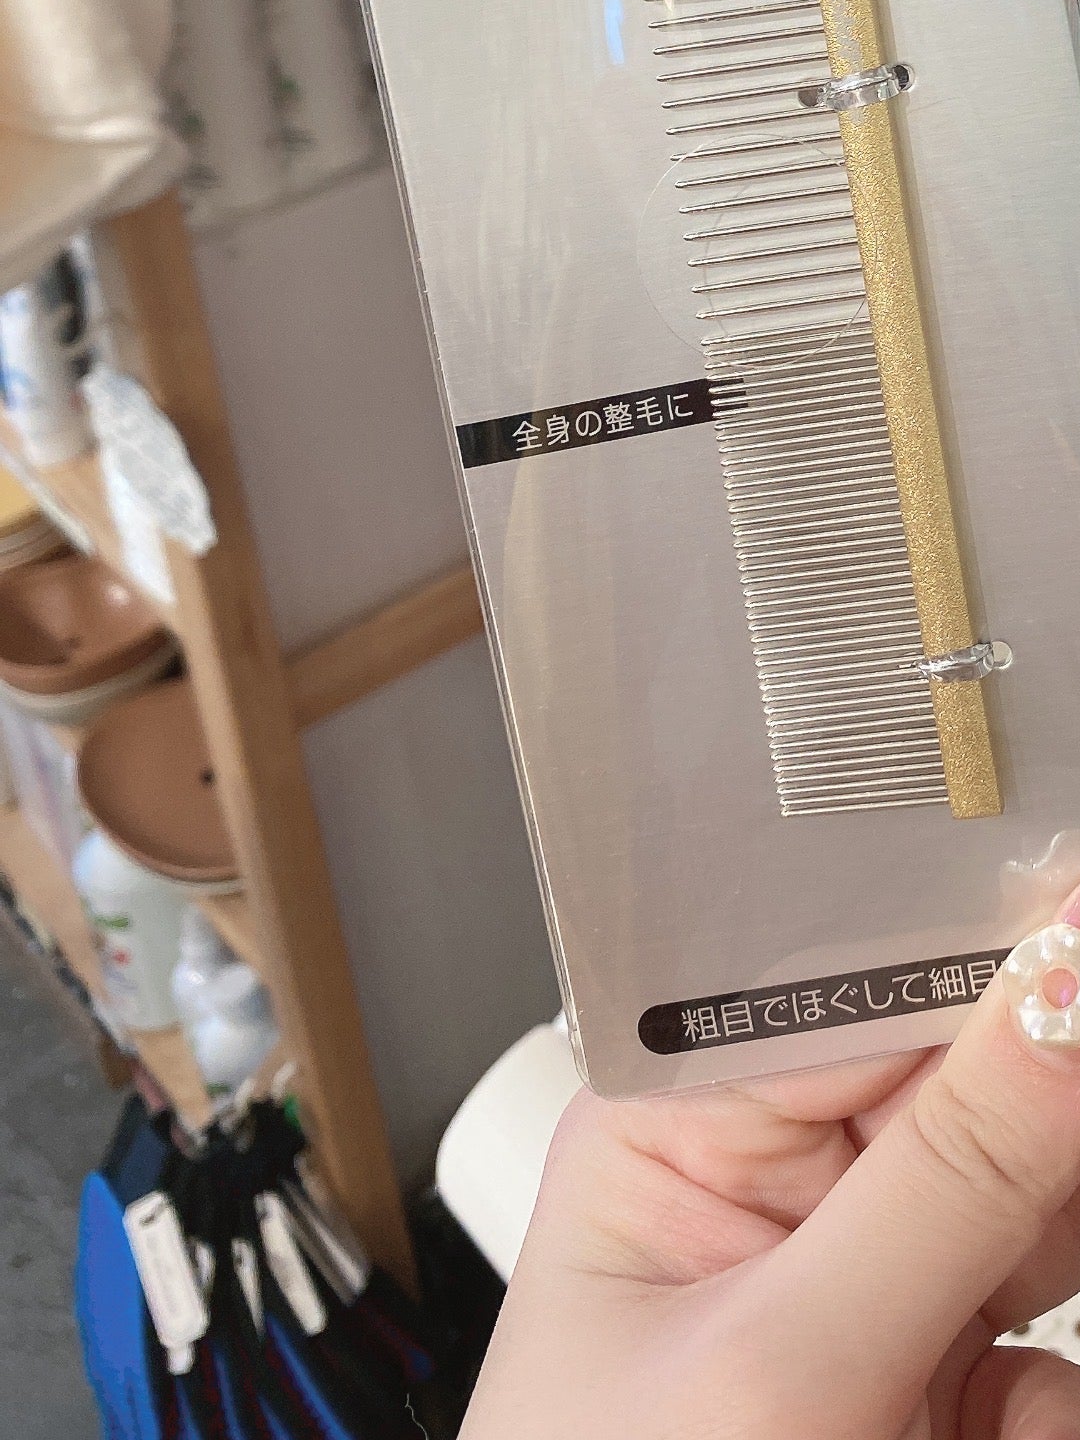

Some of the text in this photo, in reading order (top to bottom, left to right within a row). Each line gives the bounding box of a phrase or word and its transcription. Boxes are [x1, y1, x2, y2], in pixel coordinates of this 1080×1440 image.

[511, 392, 694, 452] 全身の整毛に
